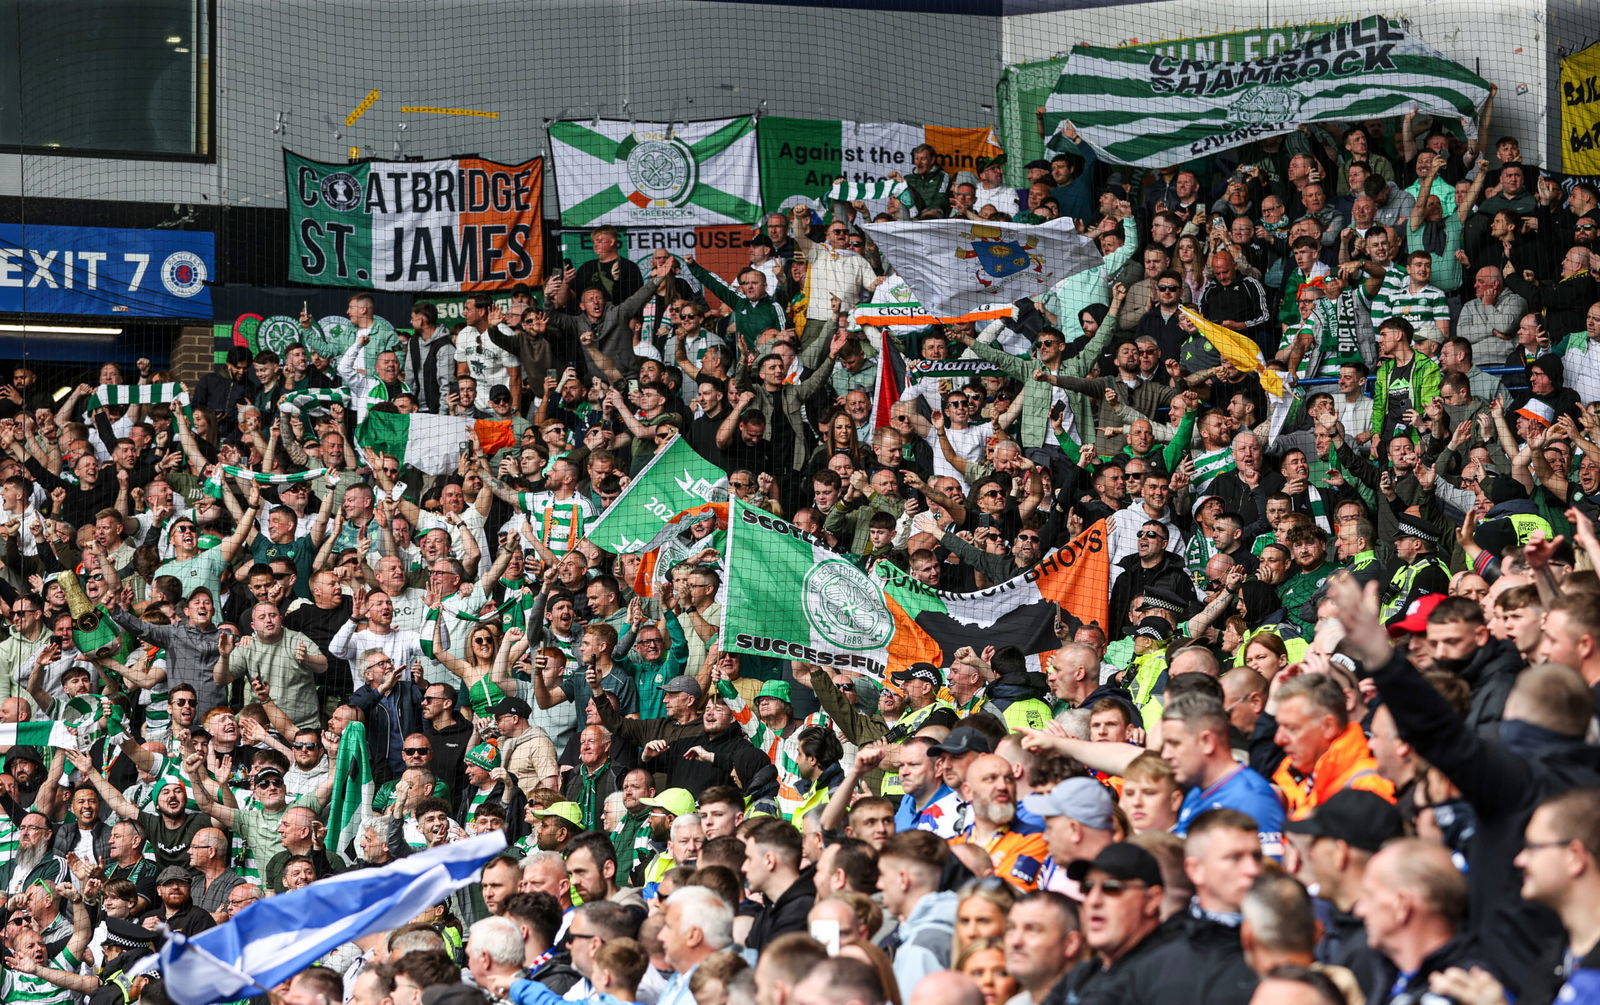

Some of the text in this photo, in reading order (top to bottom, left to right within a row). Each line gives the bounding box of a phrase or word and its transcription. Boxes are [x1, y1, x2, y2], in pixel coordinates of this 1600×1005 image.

[1150, 44, 1397, 95] SHAMROCK
[779, 142, 864, 165] Against
[869, 146, 905, 164] the
[301, 218, 531, 282] ST. JAMES
[580, 231, 742, 250] ESTERHOUSE
[0, 248, 150, 291] EXIT 7
[736, 633, 886, 679] SUCCESSFUL
